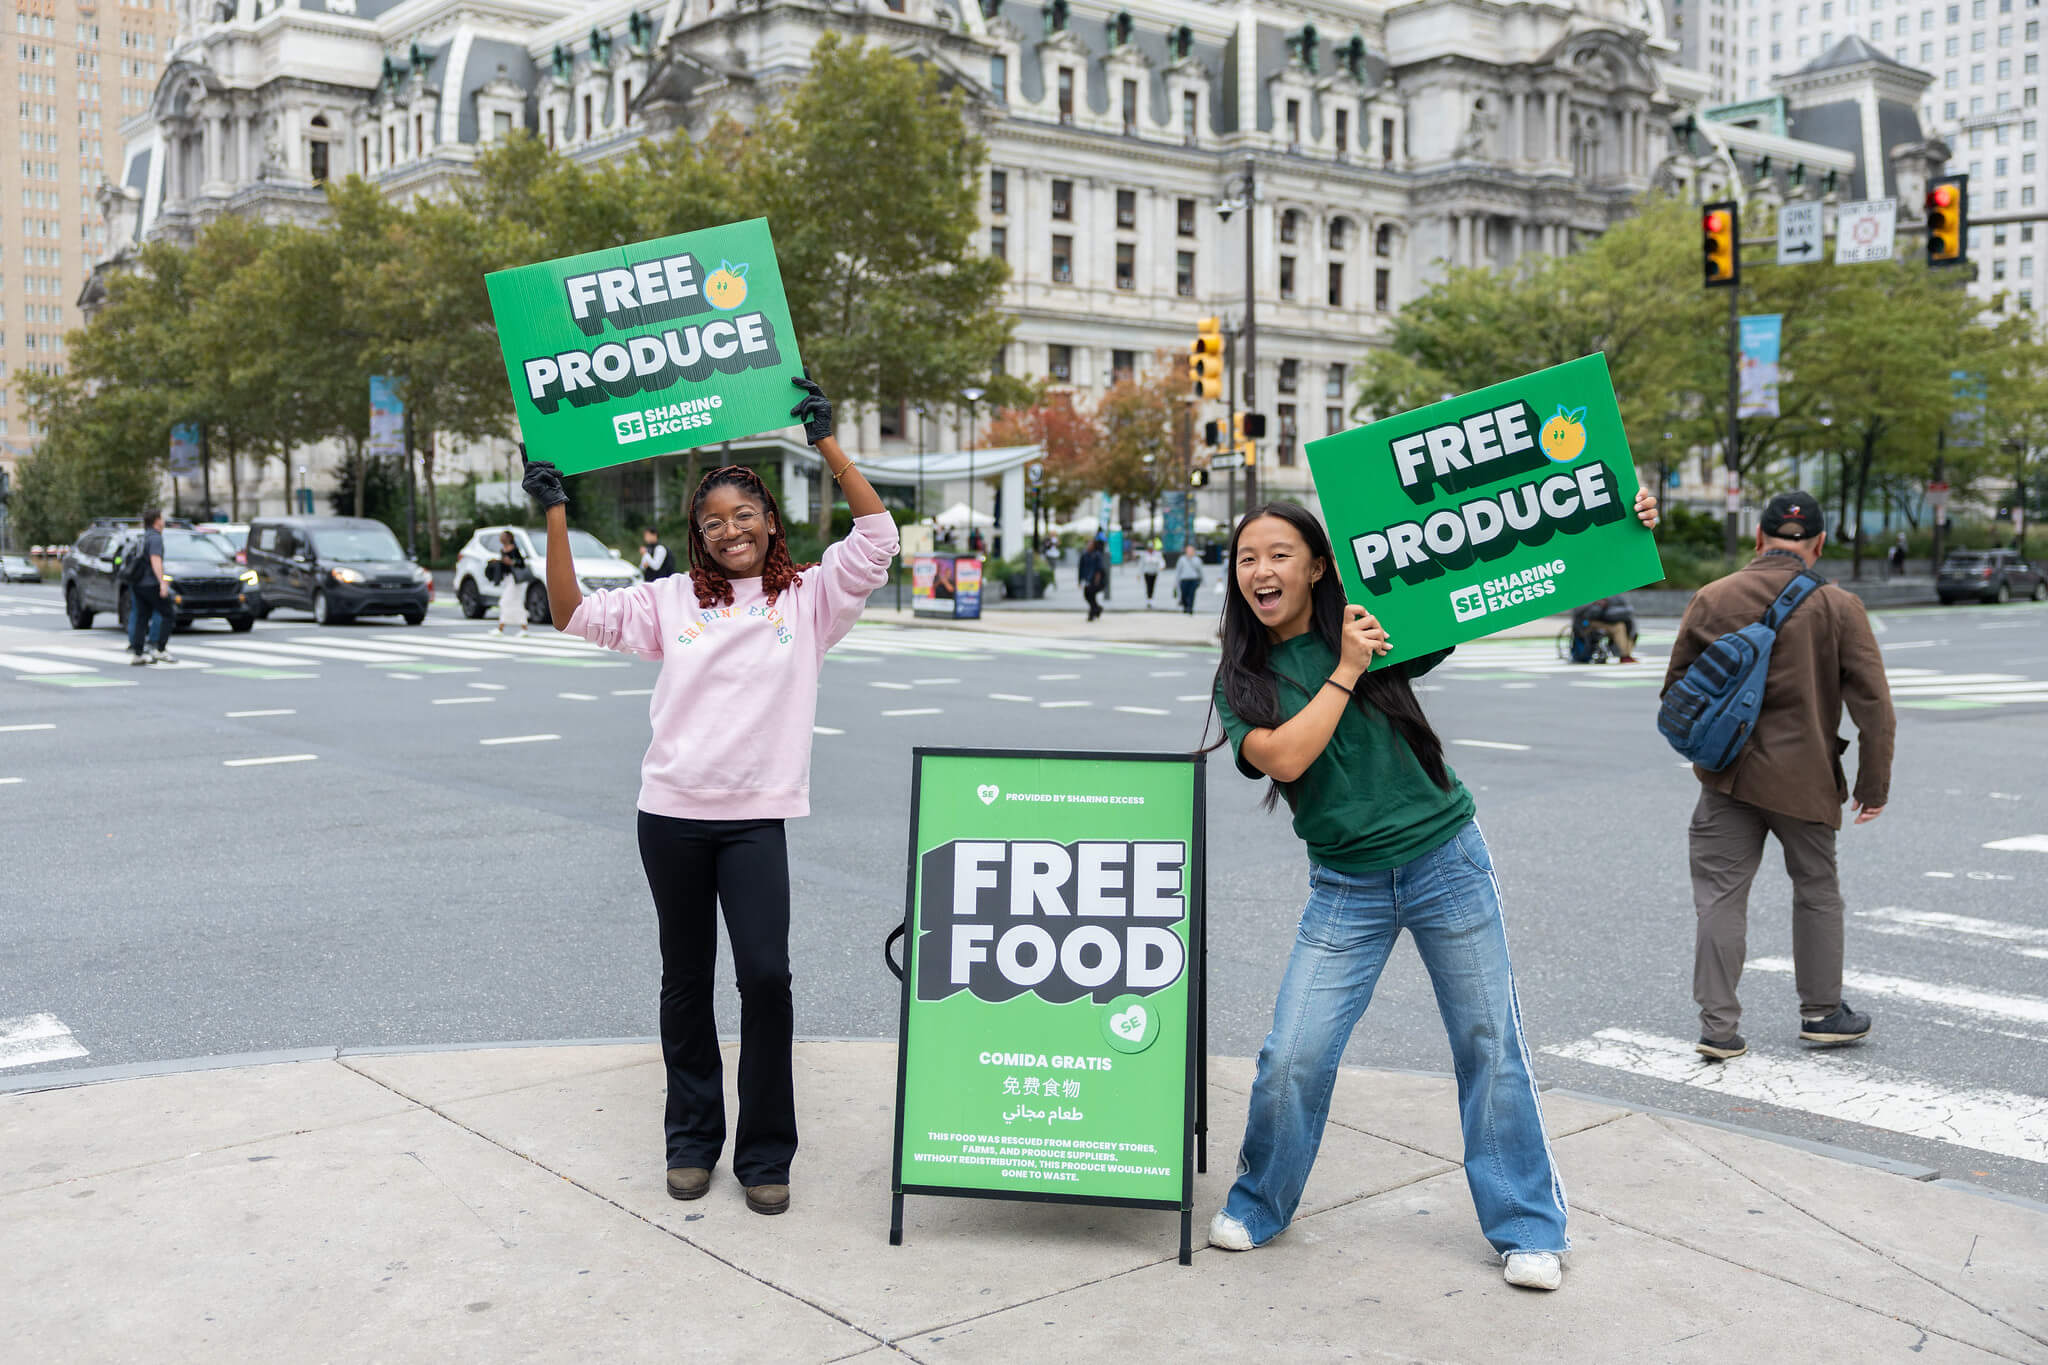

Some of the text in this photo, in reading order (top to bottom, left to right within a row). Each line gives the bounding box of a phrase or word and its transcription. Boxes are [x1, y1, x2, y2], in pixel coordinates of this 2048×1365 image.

[566, 255, 698, 320] FREE
[525, 313, 768, 400] PRODUCE
[644, 395, 722, 422] SHARING
[617, 419, 643, 437] SE
[647, 412, 712, 437] EXCESS
[1391, 402, 1534, 487] FREE
[1352, 463, 1611, 580] PRODUCE
[1483, 559, 1566, 595] SHARING
[1455, 592, 1482, 613] SE
[1487, 579, 1556, 612] EXCESS
[748, 606, 793, 645] EXCESS
[982, 790, 994, 798] SE
[1006, 793, 1145, 804] PROVIDED BY SHARING EXCESS
[953, 842, 1184, 917] FREE
[951, 924, 1185, 987] FOOD
[1120, 1016, 1142, 1033] SE
[979, 1052, 1112, 1071] COMIDA GRATIS
[1002, 1076, 1081, 1098] 免费食物
[1002, 1104, 1084, 1126] طعام مجاني
[928, 1132, 1158, 1154] THIS FOOD WAS RESCUED FROM GROCERY STORES,
[999, 1147, 1020, 1156] AND
[1022, 1148, 1066, 1158] PRODUCE
[1067, 1151, 1119, 1162] SUPPLIERS.
[914, 1153, 958, 1164] WITHOUT
[1039, 1160, 1060, 1169] THIS
[1061, 1161, 1106, 1172] PRODUCE
[1107, 1164, 1143, 1174] WOULD
[1143, 1166, 1171, 1176] HAVE
[1001, 1169, 1080, 1181] GONE TO WASTE.
